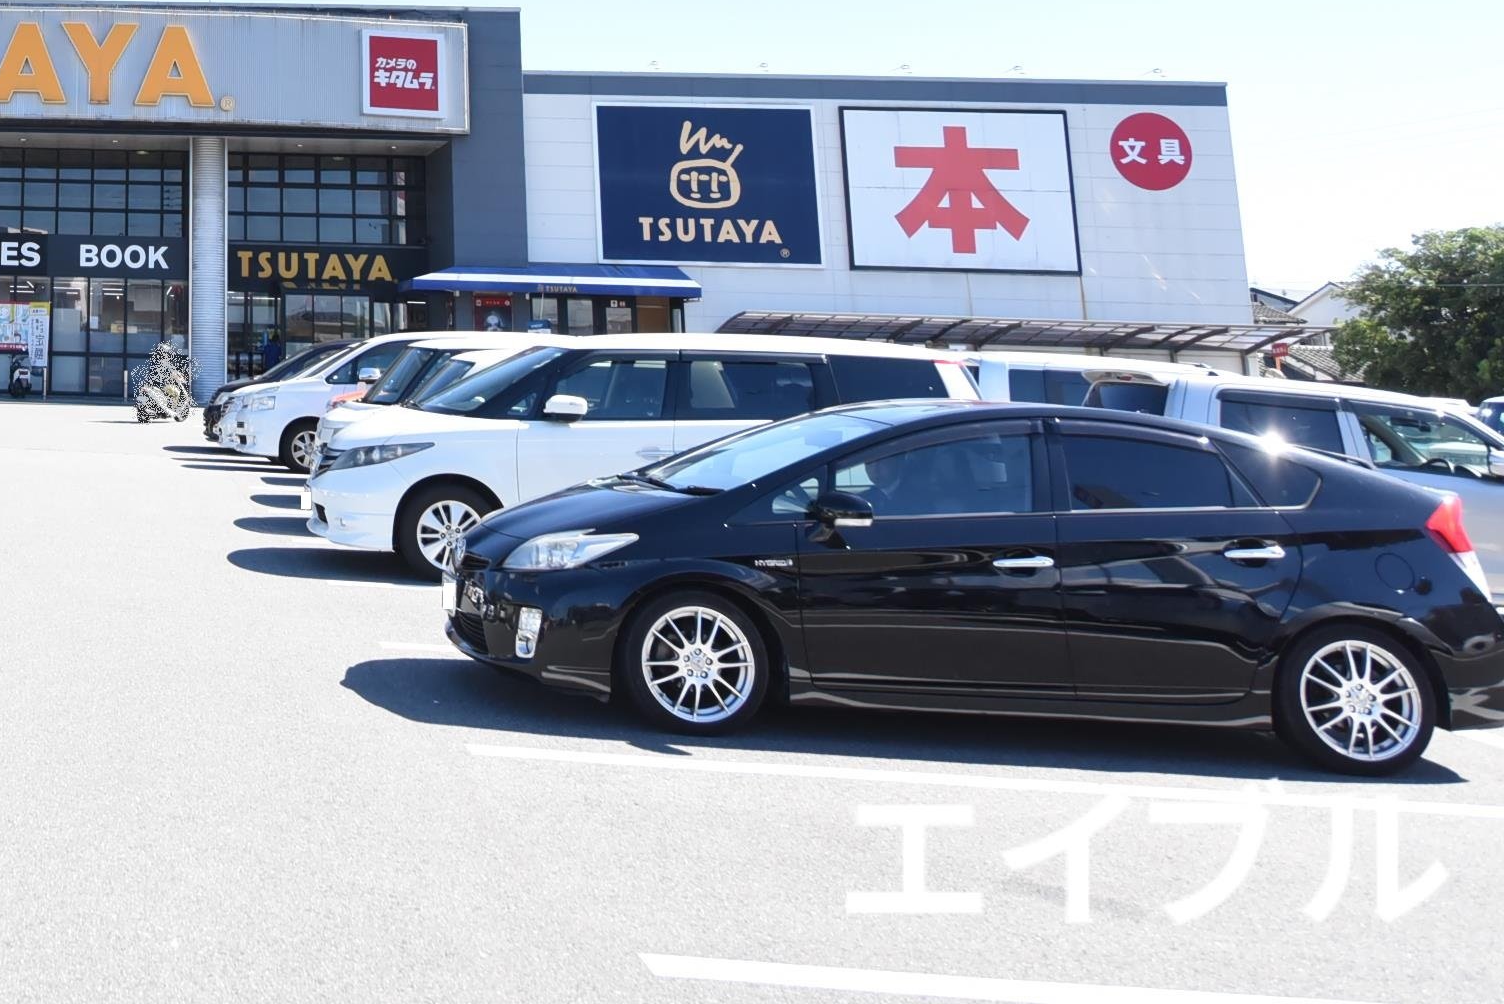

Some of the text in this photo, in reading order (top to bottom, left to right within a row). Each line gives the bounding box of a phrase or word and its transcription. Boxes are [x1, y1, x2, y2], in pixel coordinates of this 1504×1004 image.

[375, 57, 417, 70] カメラの
[373, 69, 433, 90] キタムラ
[1118, 138, 1186, 165] 文具
[894, 126, 1030, 254] 本
[638, 216, 782, 245] TSUTAYA
[79, 243, 169, 270] BOOK
[237, 251, 393, 282] TSUTAYA
[546, 285, 578, 293] TSUTAYA
